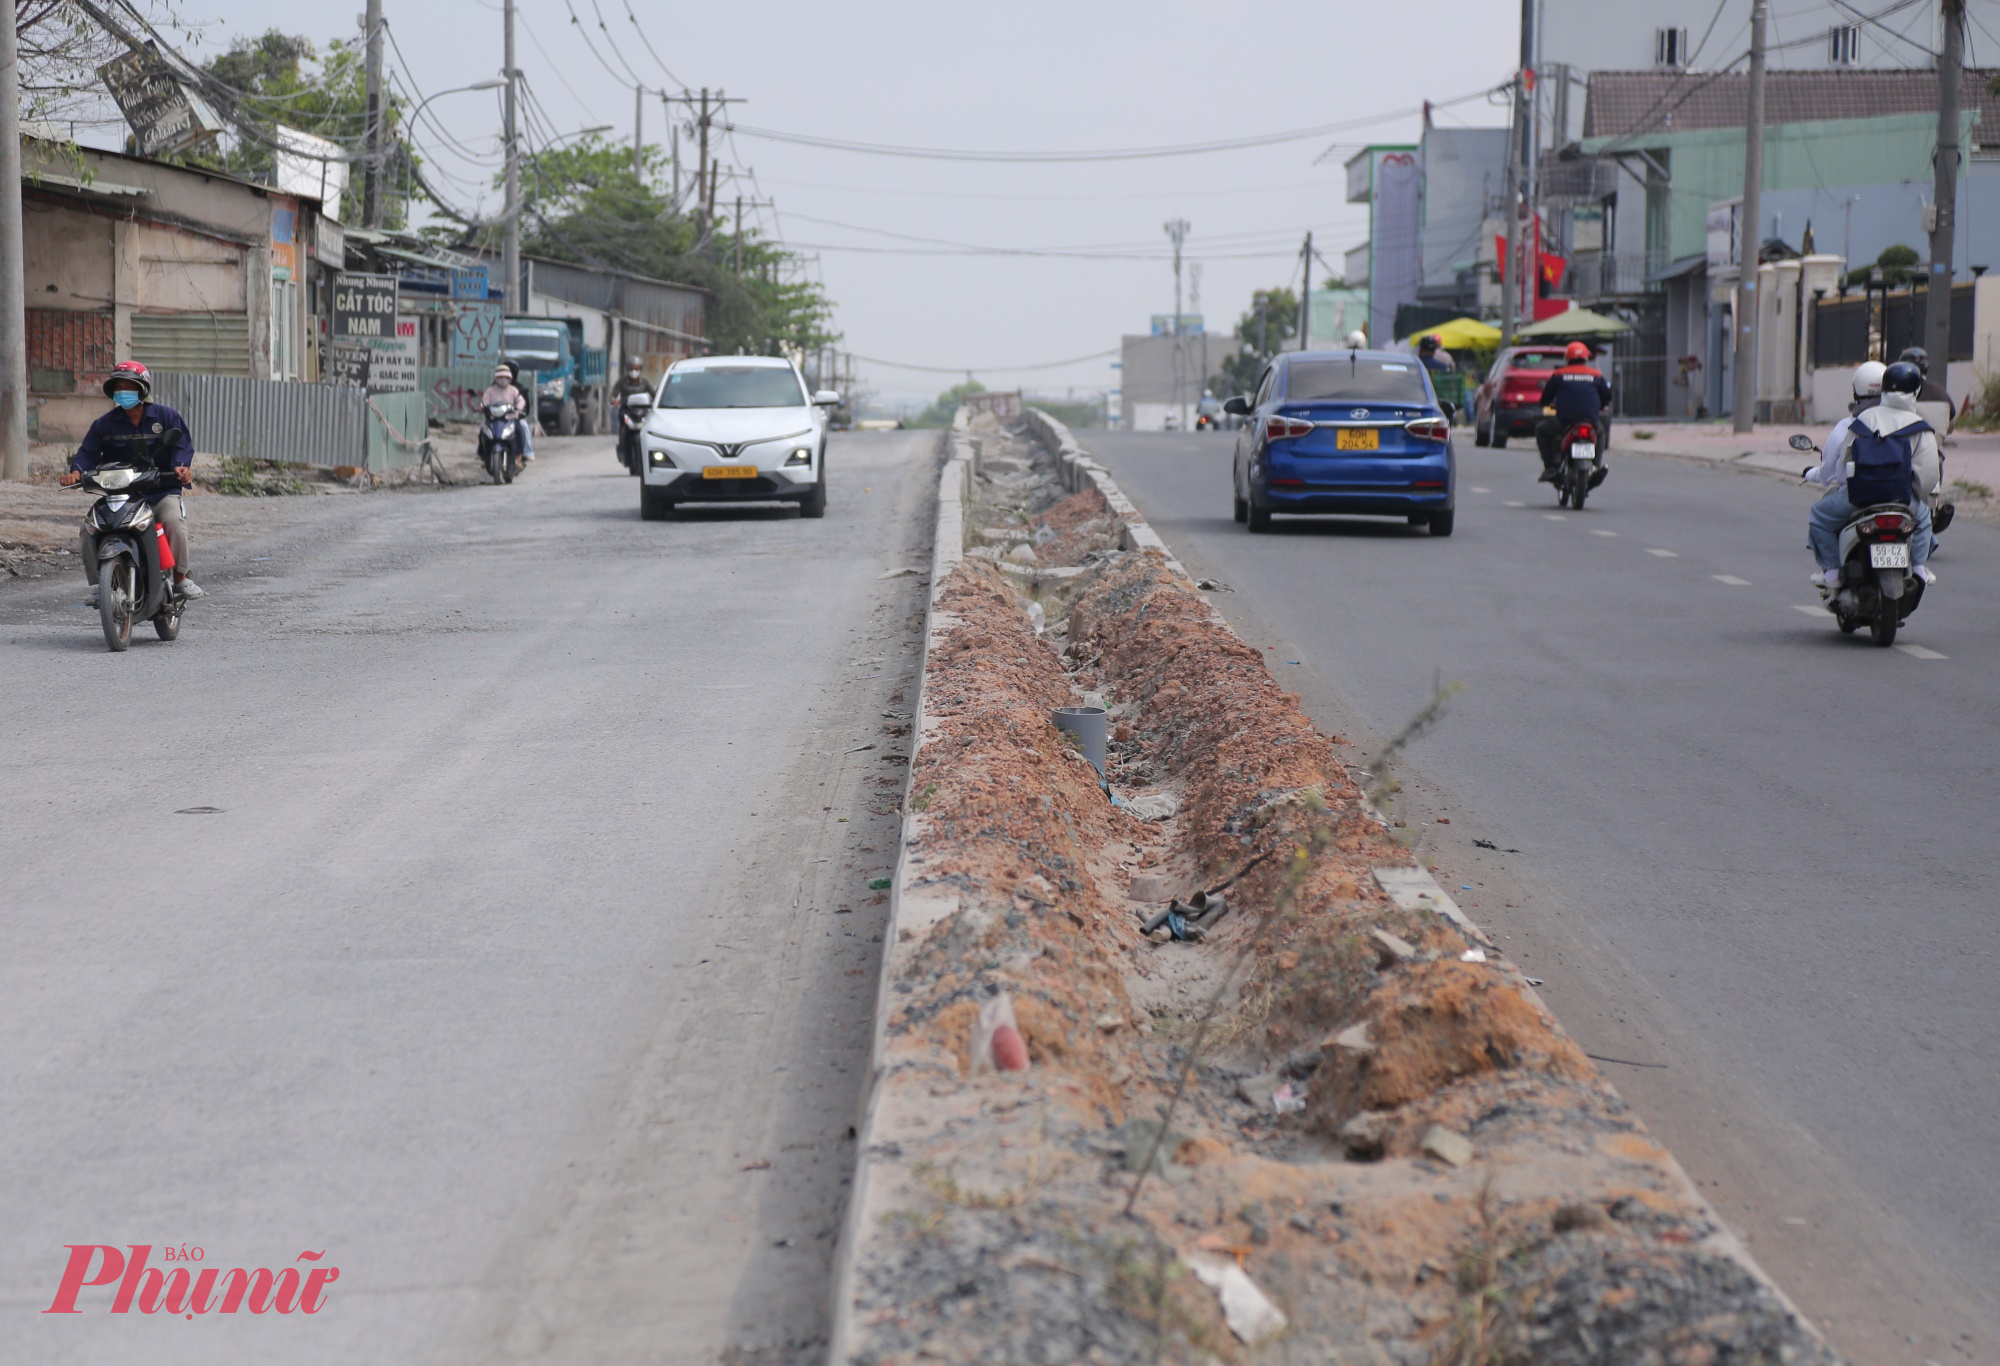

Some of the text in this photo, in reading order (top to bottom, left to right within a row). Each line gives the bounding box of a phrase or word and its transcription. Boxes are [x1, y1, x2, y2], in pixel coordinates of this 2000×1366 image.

[336, 275, 395, 291] Nhung Nhung
[336, 288, 393, 314] CẮT TÓC
[347, 317, 381, 336] NAM
